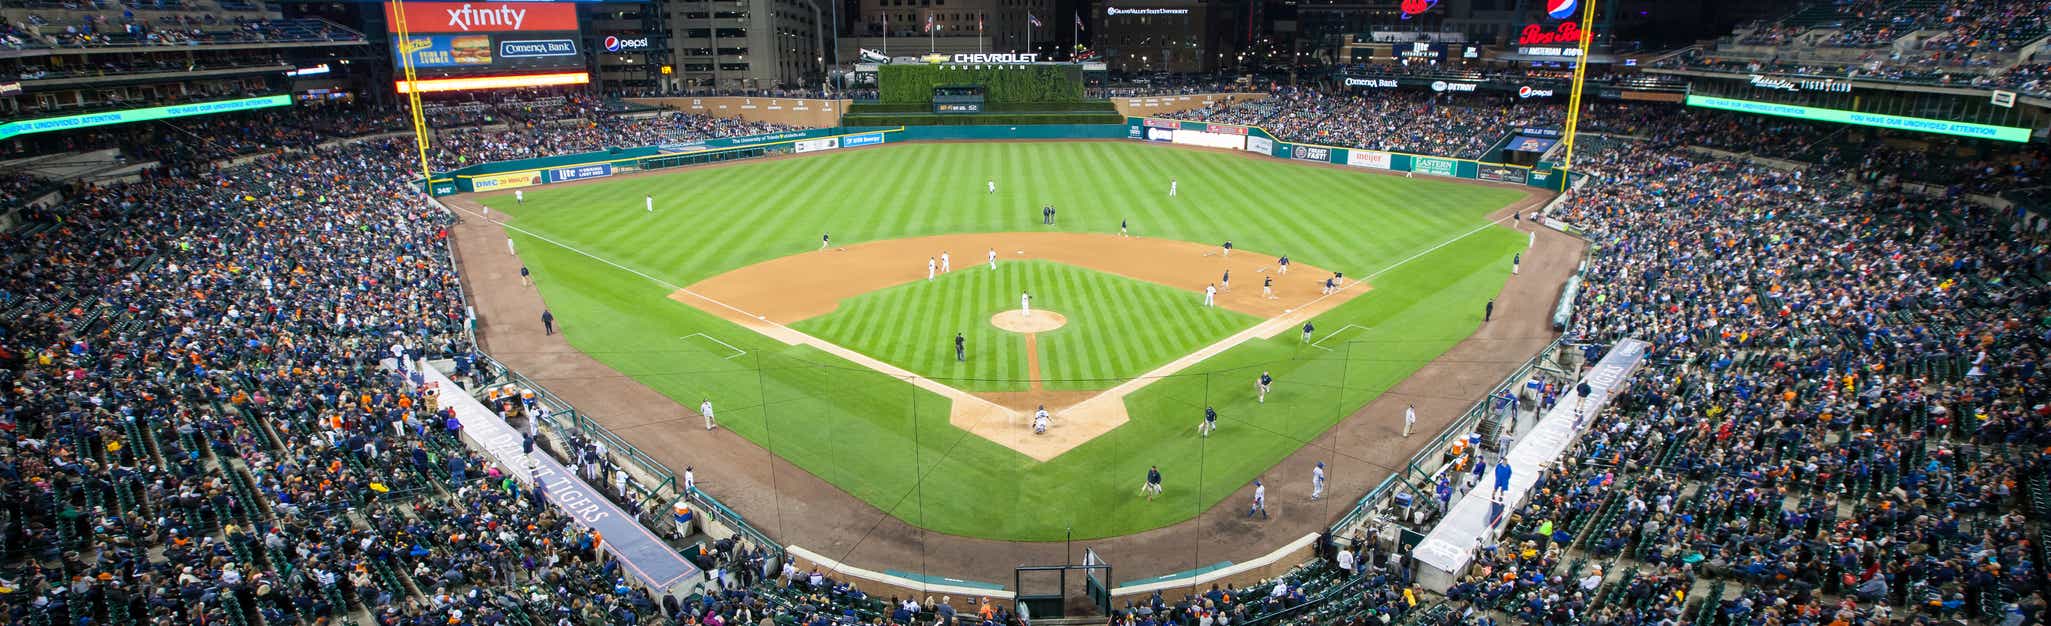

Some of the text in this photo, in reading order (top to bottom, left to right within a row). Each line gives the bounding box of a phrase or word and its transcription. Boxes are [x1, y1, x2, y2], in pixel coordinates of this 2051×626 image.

[446, 3, 526, 31] xfinity
[506, 43, 570, 54] Comerica Bank
[620, 37, 648, 49] pepsi
[954, 53, 1038, 63] CHEVROLET
[1378, 79, 1398, 88] Bank
[1447, 83, 1477, 92] DETROIT
[1800, 80, 1852, 93] TIGER CLUB
[1531, 88, 1553, 97] pepsi
[1865, 116, 1884, 124] HAVE
[1903, 119, 1947, 131] UNDIVIDED
[1949, 125, 1996, 136] ATTENTION
[1356, 152, 1381, 163] meijer
[1416, 156, 1451, 169] EASTERN
[547, 476, 609, 523] TIGERS
